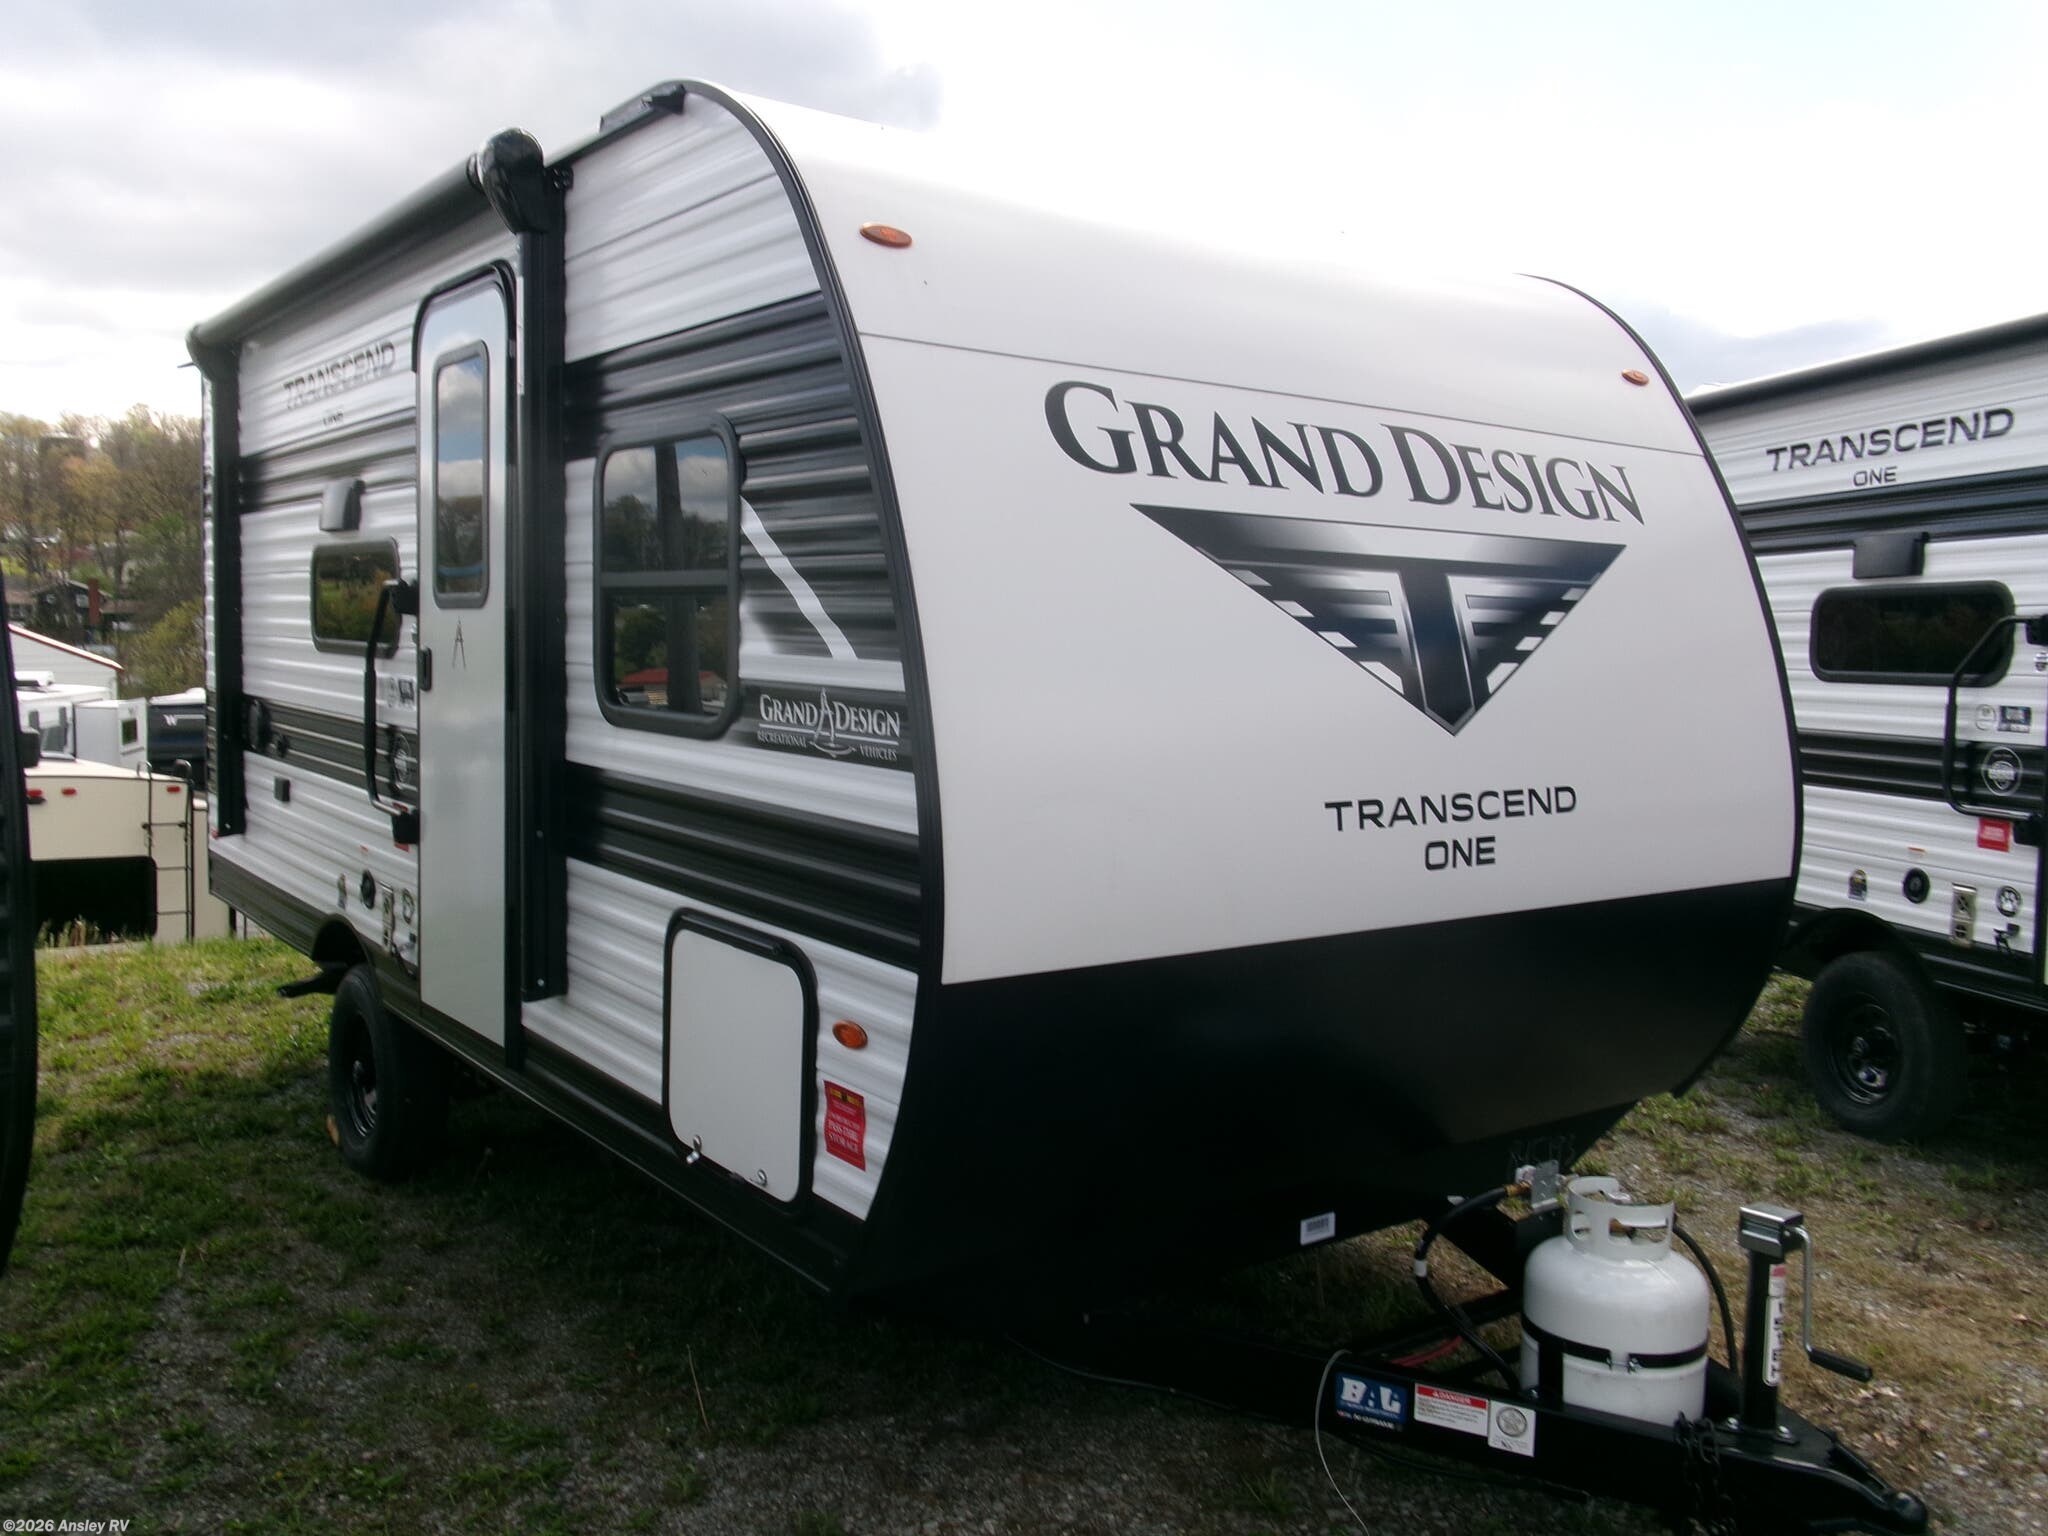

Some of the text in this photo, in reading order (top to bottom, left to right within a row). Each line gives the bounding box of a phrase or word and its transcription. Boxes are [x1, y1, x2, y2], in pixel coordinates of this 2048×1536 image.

[284, 342, 395, 410] TRANSCEND
[1044, 380, 1645, 526] GRAND DESIGN
[1766, 407, 2015, 472] TRANSCEND
[1853, 466, 1898, 487] ONE
[759, 694, 900, 737] GRAND DESIGN
[859, 744, 898, 761] VEHICLES
[1324, 786, 1577, 832] TRANSCEND
[1424, 836, 1496, 871] ONE
